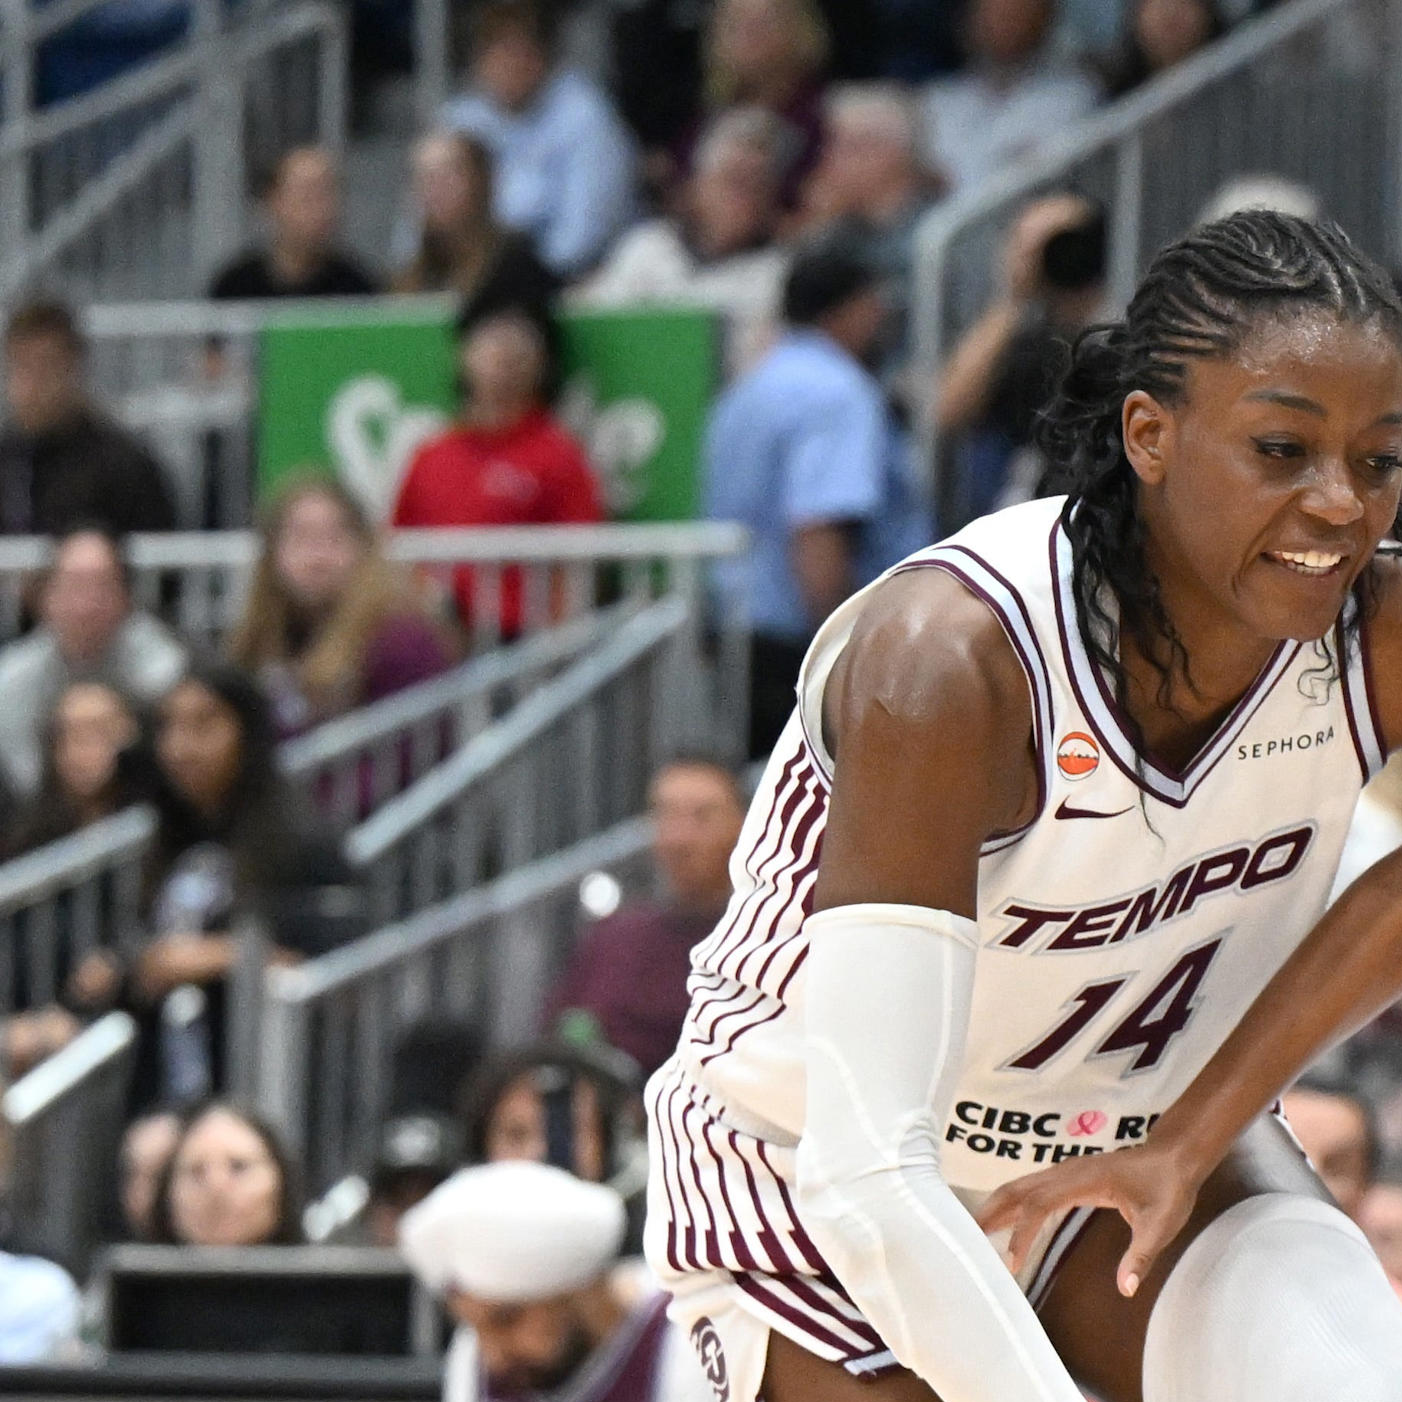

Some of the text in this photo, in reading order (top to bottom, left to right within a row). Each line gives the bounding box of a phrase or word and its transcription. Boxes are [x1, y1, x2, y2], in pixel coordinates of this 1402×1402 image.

[1238, 725, 1335, 760] SEPHORA
[997, 825, 1314, 952] TEMPO
[1004, 936, 1226, 1073] 14
[955, 1100, 1061, 1137] CIBC
[945, 1123, 1023, 1160] FOR
